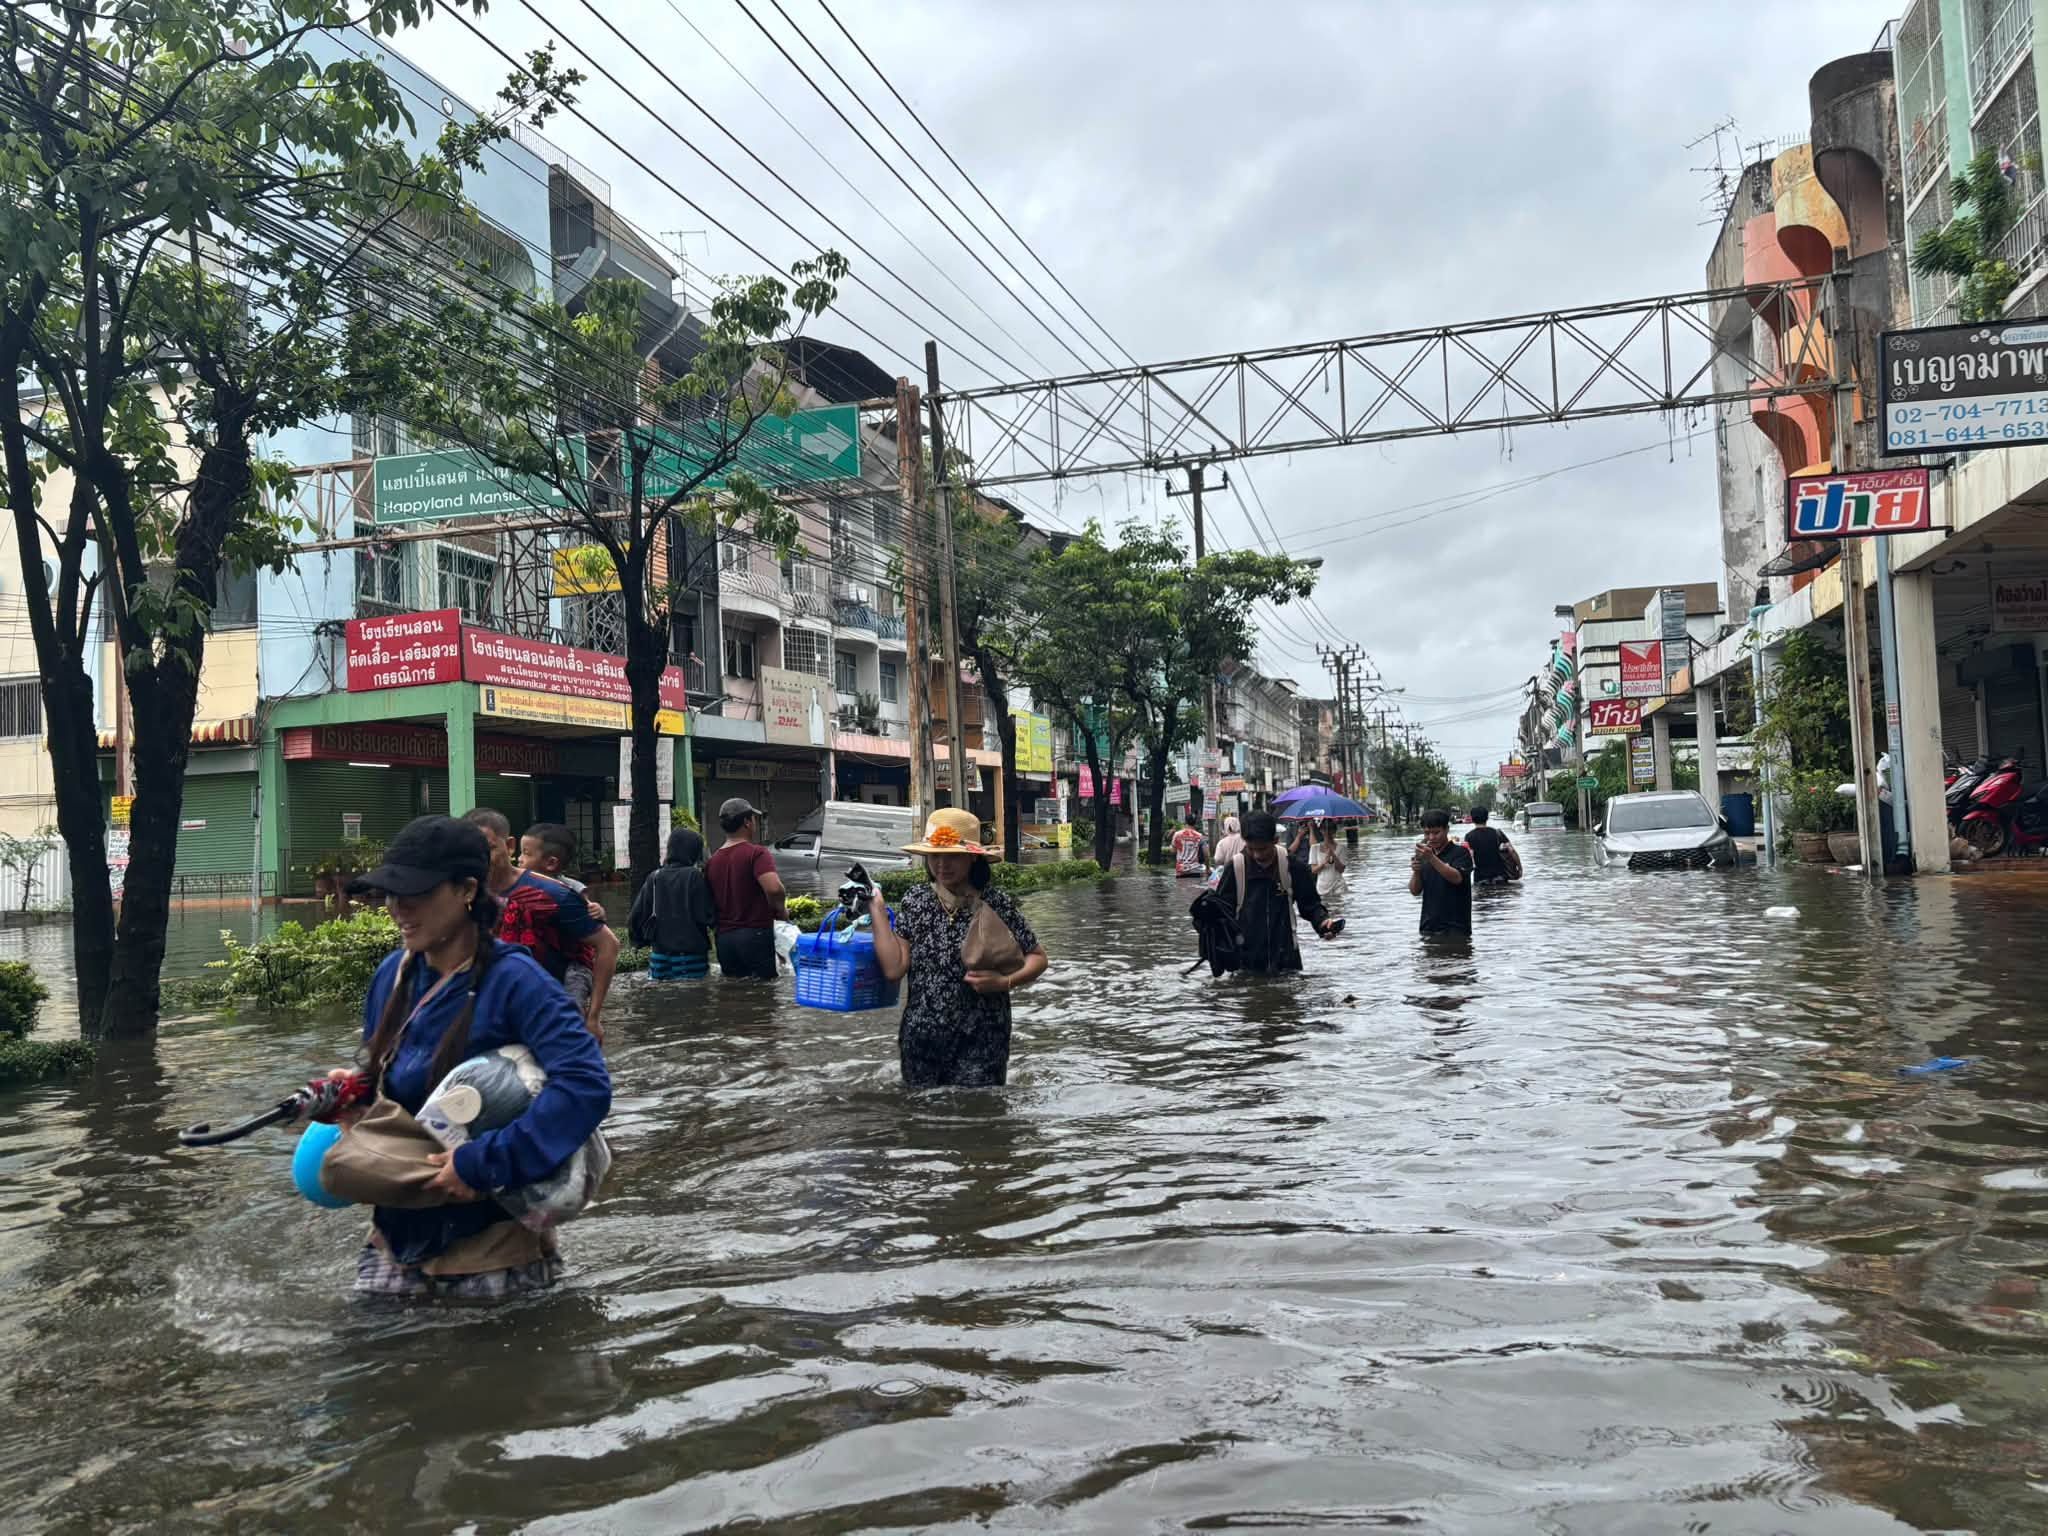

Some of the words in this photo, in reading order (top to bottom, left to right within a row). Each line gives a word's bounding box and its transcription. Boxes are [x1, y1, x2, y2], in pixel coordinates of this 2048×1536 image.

[1893, 348, 2048, 392] เบญจมาพ
[1889, 421, 2048, 446] 081-644-653
[383, 493, 463, 514] Happyland
[1794, 480, 1924, 534] ป้าย
[360, 618, 443, 640] โรงเรียนสอน
[373, 662, 436, 686] กรรณิการ์
[1593, 703, 1638, 726] ป้าย
